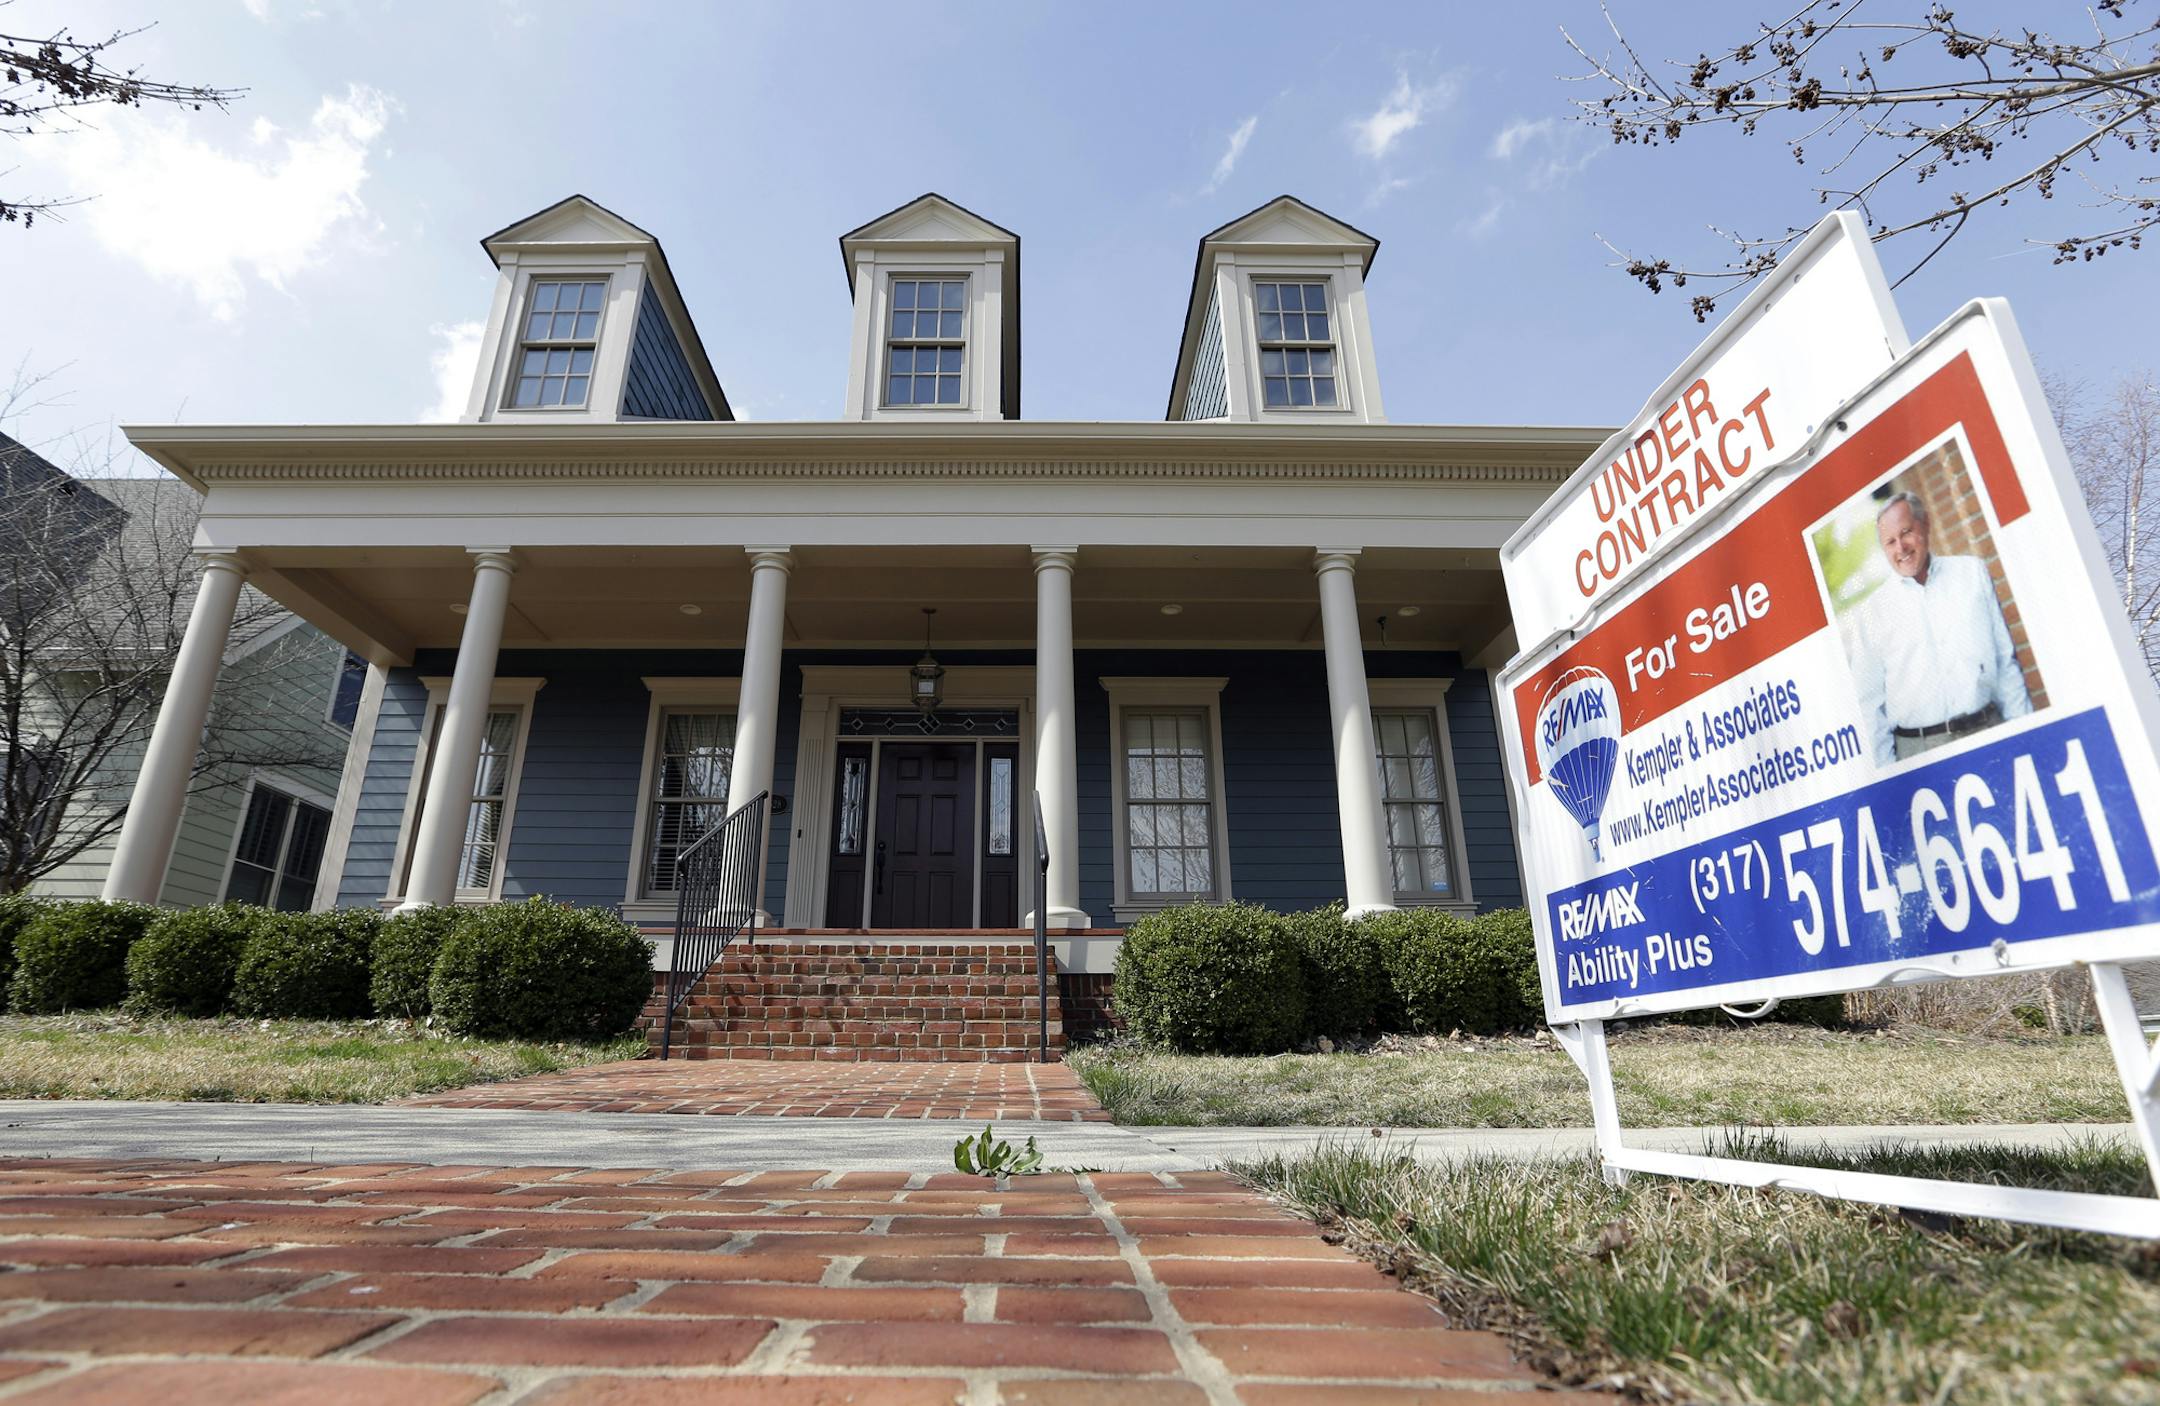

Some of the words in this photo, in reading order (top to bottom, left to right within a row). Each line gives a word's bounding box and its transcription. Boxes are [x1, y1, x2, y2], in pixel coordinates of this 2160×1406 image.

[1575, 387, 1775, 598] CONTRACT
[1591, 378, 1719, 523] UNDER
[1625, 634, 1678, 692] For
[1685, 582, 1770, 654] Sale
[1542, 687, 1608, 752] RE/MAX
[1625, 728, 1683, 789] Kempler
[1687, 720, 1701, 761] &
[1703, 679, 1801, 750] Associates
[1610, 724, 1862, 847] www.KemplerAssociates.com
[1690, 839, 1771, 914] (317)
[1779, 738, 2131, 957] 574-6641
[1558, 881, 1646, 942] RE/MAX
[1567, 943, 1639, 989] Ability
[1646, 932, 1714, 975] Plus
